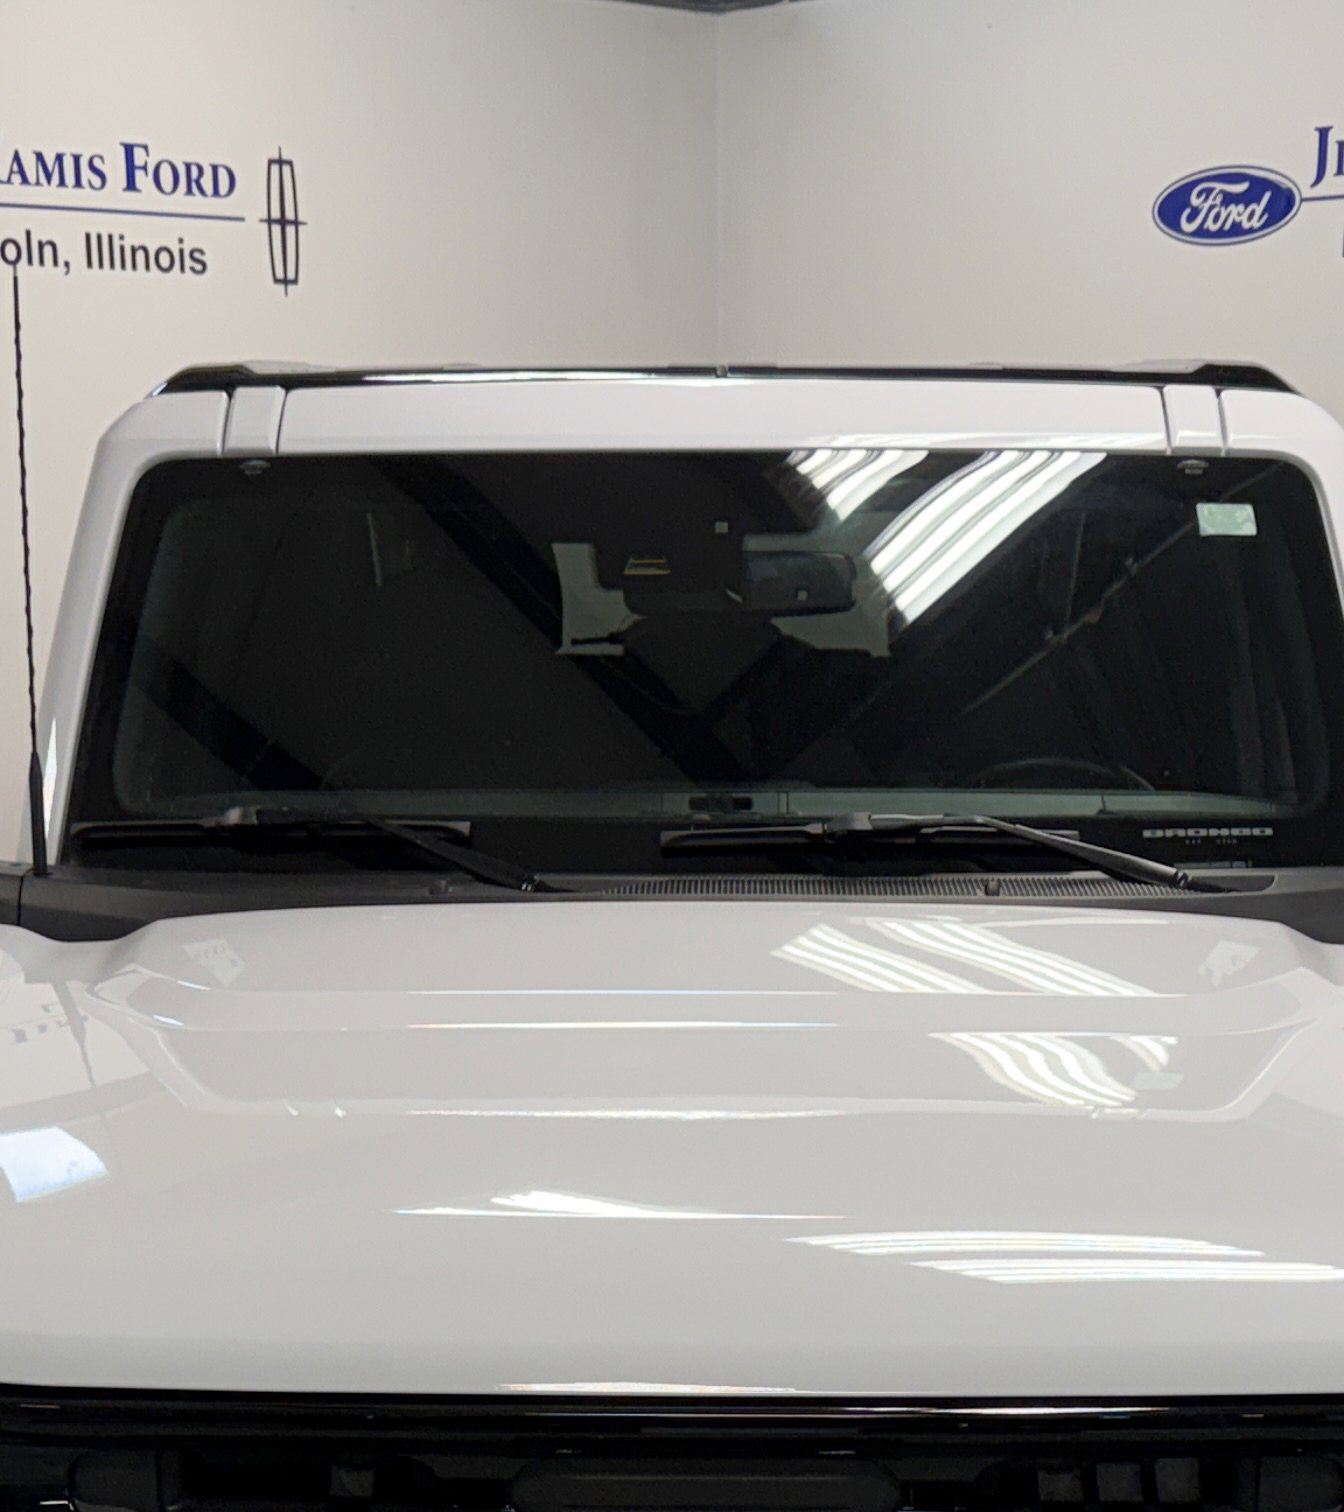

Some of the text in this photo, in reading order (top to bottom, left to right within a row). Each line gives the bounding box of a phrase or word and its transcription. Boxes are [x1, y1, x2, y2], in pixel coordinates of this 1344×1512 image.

[119, 142, 237, 198] FORD
[1180, 181, 1269, 232] Ford
[84, 232, 208, 275] Illinois
